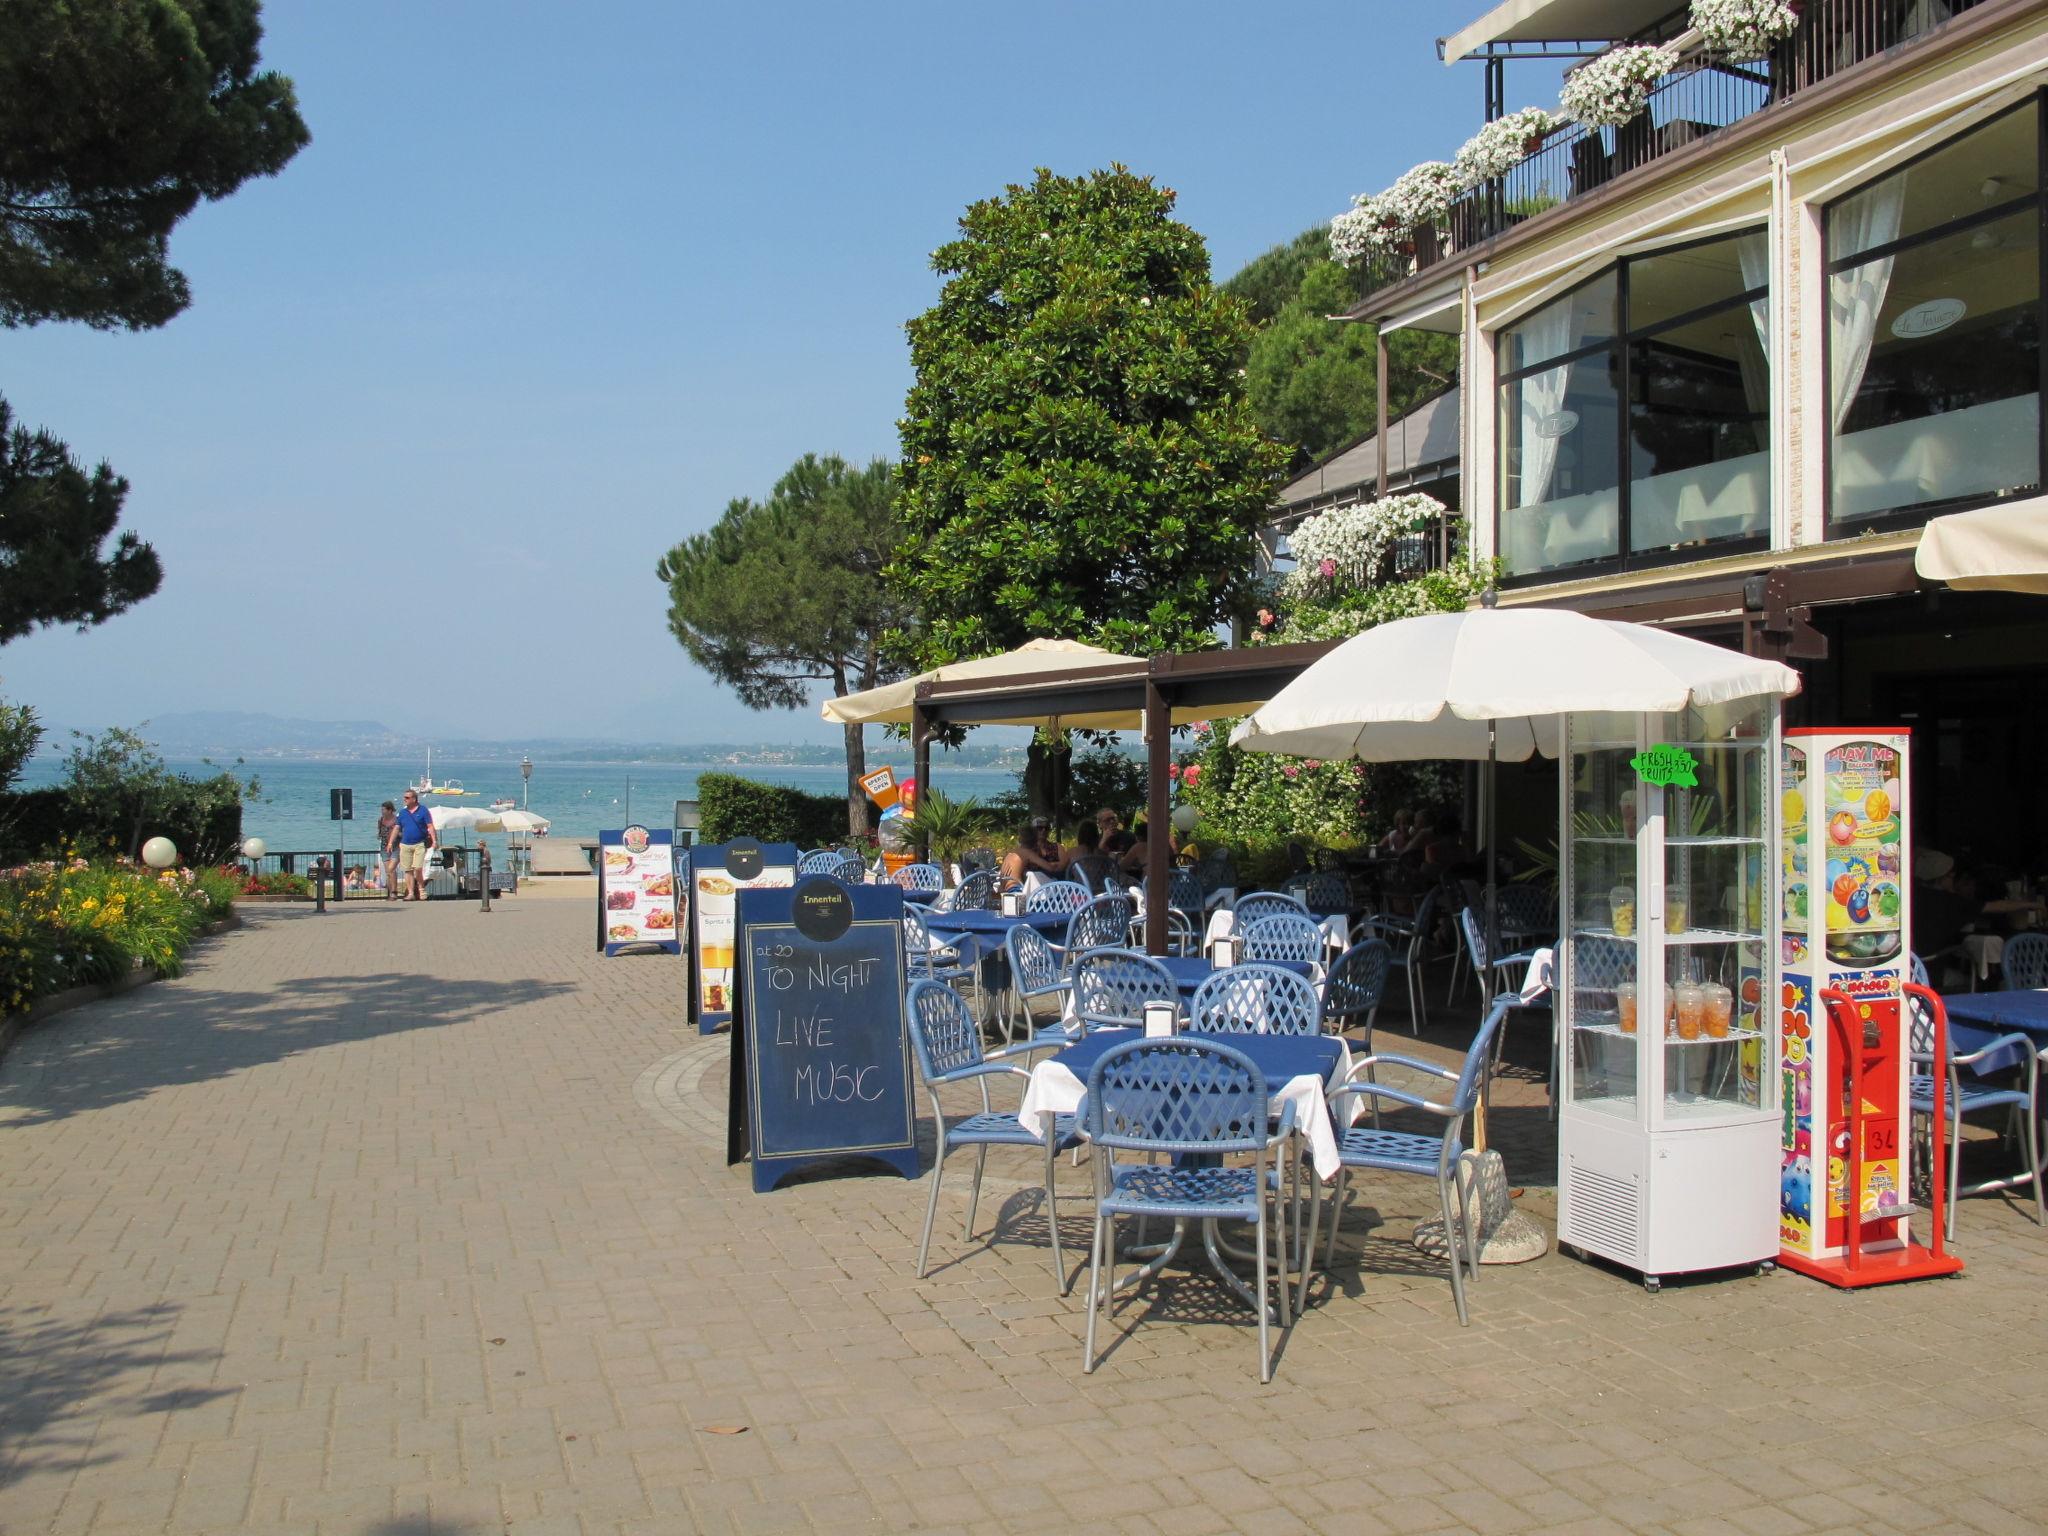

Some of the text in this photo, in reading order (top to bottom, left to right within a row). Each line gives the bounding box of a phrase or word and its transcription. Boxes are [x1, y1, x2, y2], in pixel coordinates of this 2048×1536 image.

[1828, 747, 1894, 762] PLAY ME
[867, 773, 888, 787] APERTO
[1640, 767, 1673, 781] FRUITS
[873, 781, 889, 792] OPEN
[803, 894, 842, 904] Innenteil
[756, 945, 794, 957] at 20
[762, 952, 880, 993] TO NIGHT
[776, 1003, 834, 1048] LIVE
[796, 1061, 885, 1106] MUSIC
